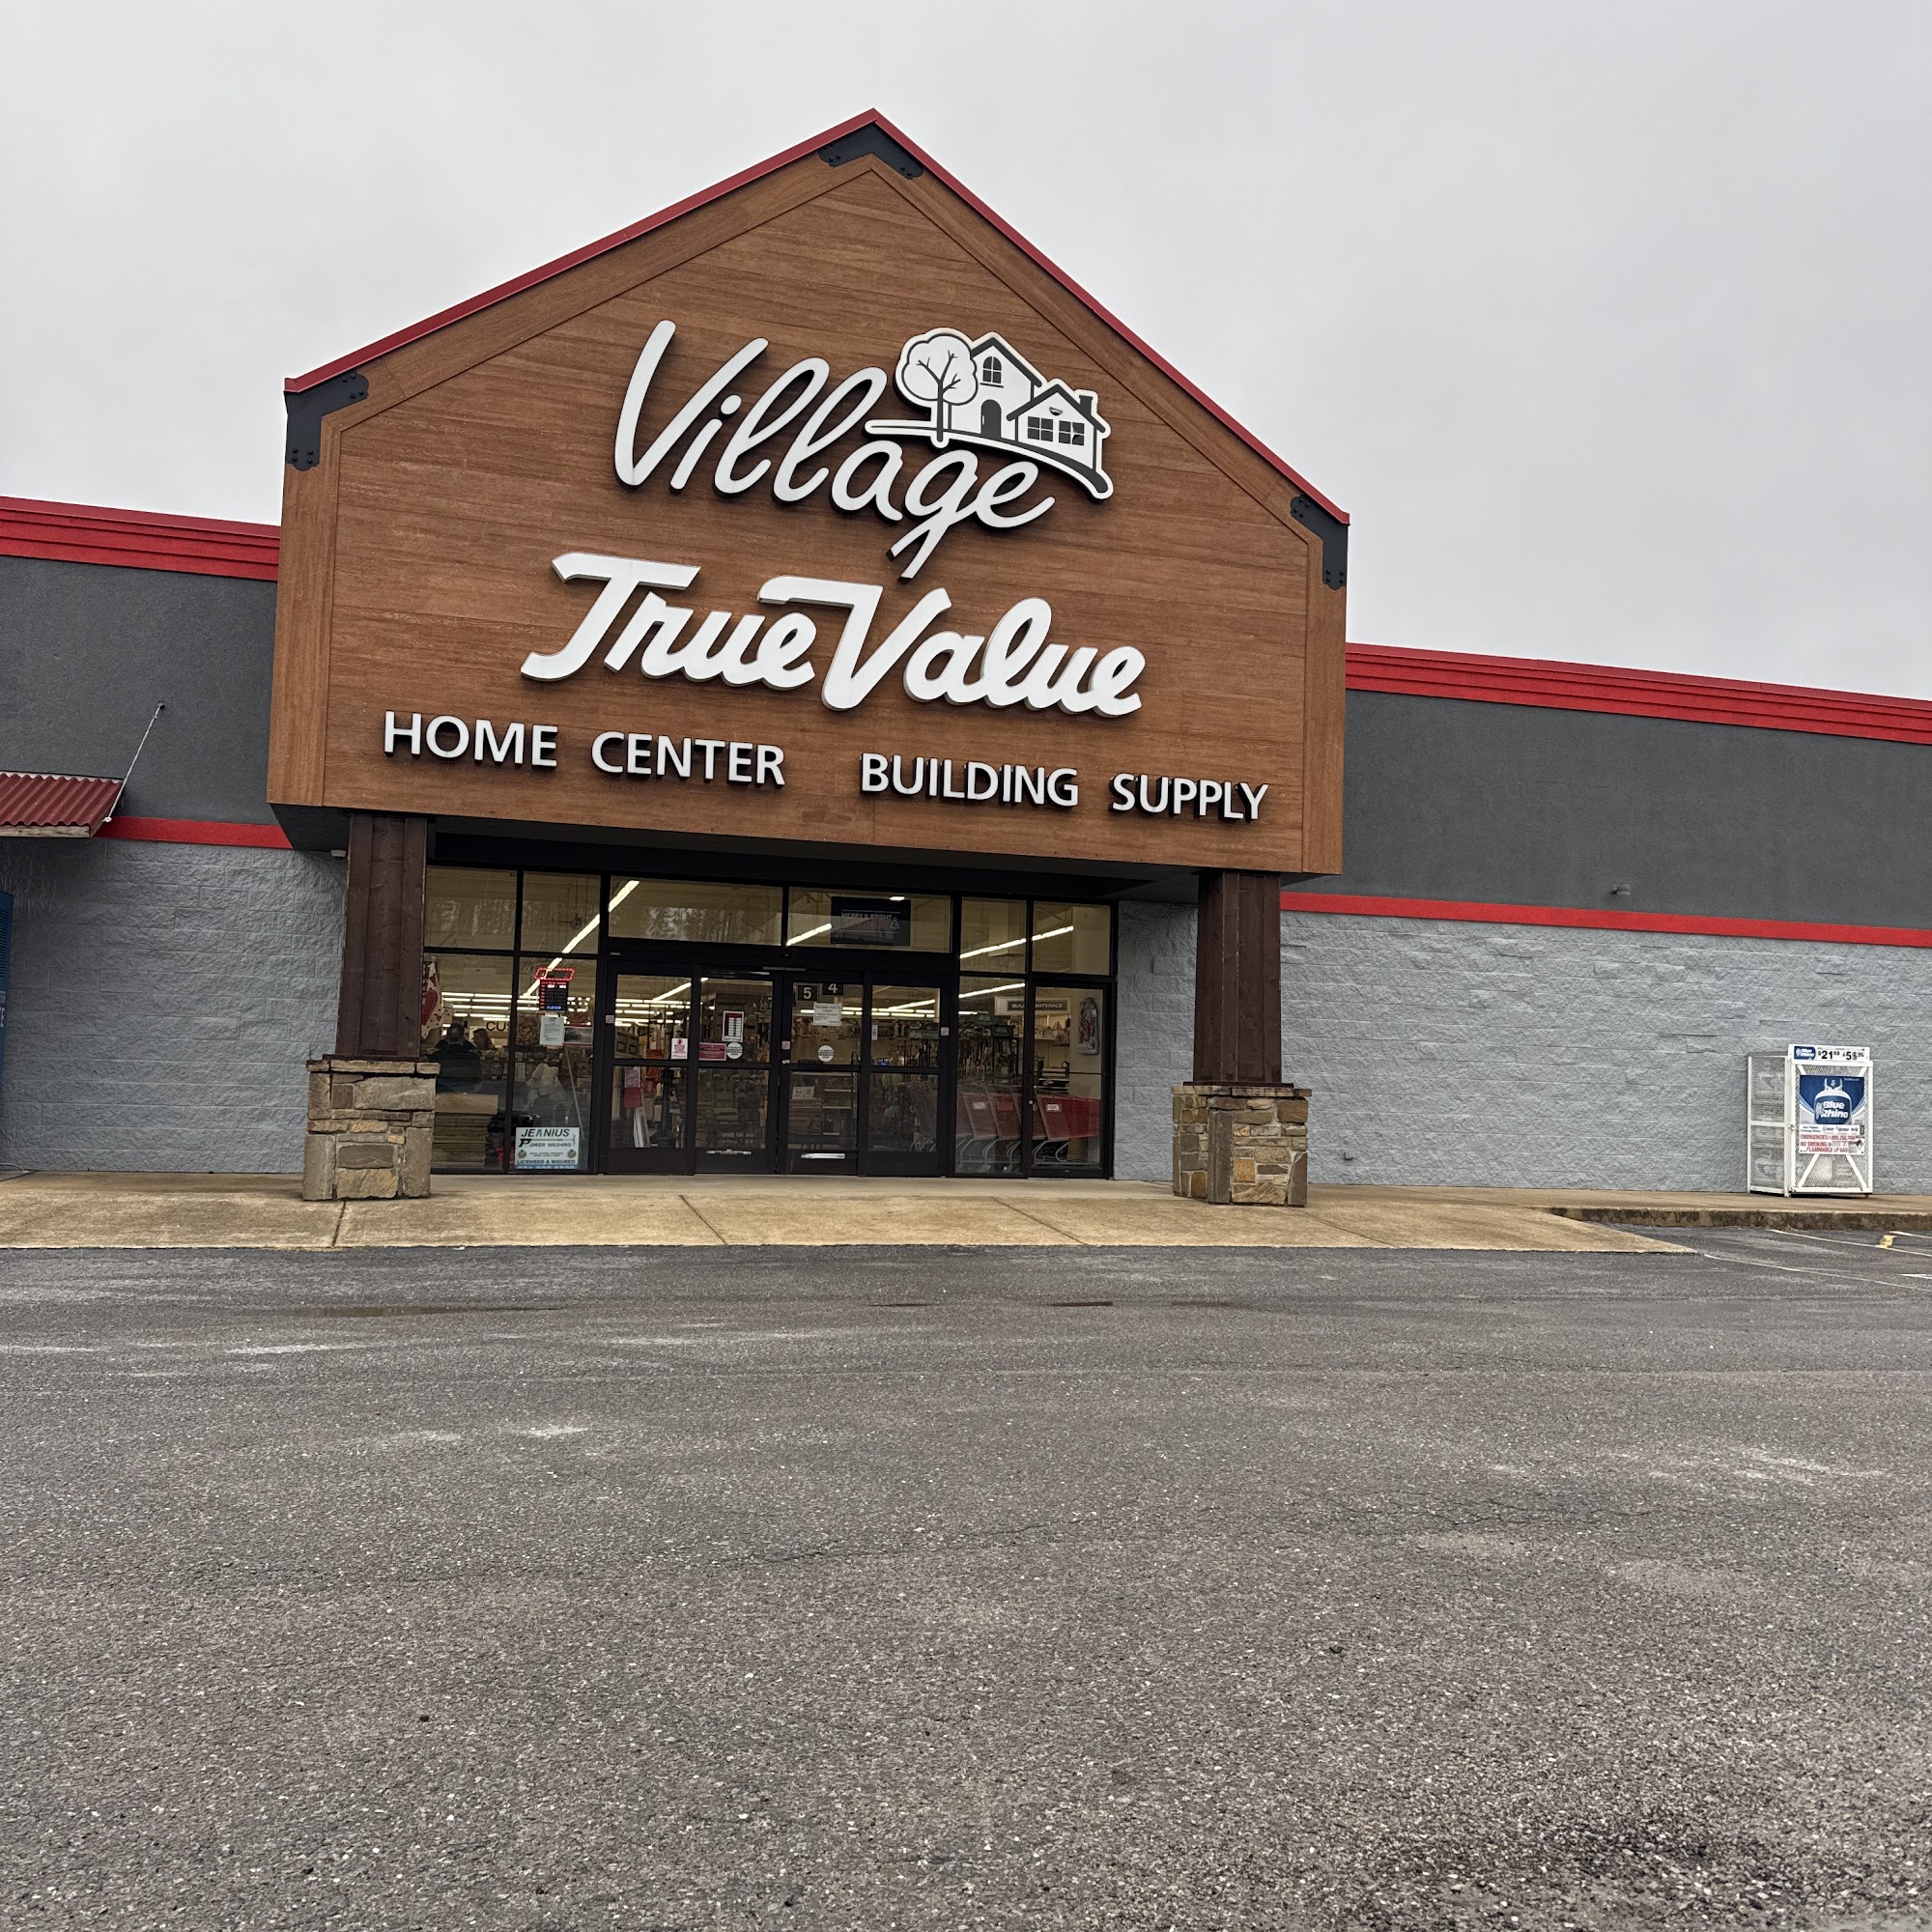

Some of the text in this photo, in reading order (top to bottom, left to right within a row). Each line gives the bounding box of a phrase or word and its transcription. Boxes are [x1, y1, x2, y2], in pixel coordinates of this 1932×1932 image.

[613, 320, 1056, 580] Village
[521, 552, 1147, 719] True Value
[384, 710, 1269, 820] HOME CENTER BUILDING SUPPLY
[803, 986, 811, 1000] 5
[828, 983, 838, 994] 4
[1823, 1100, 1845, 1109] Blue
[519, 1138, 546, 1148] POWER
